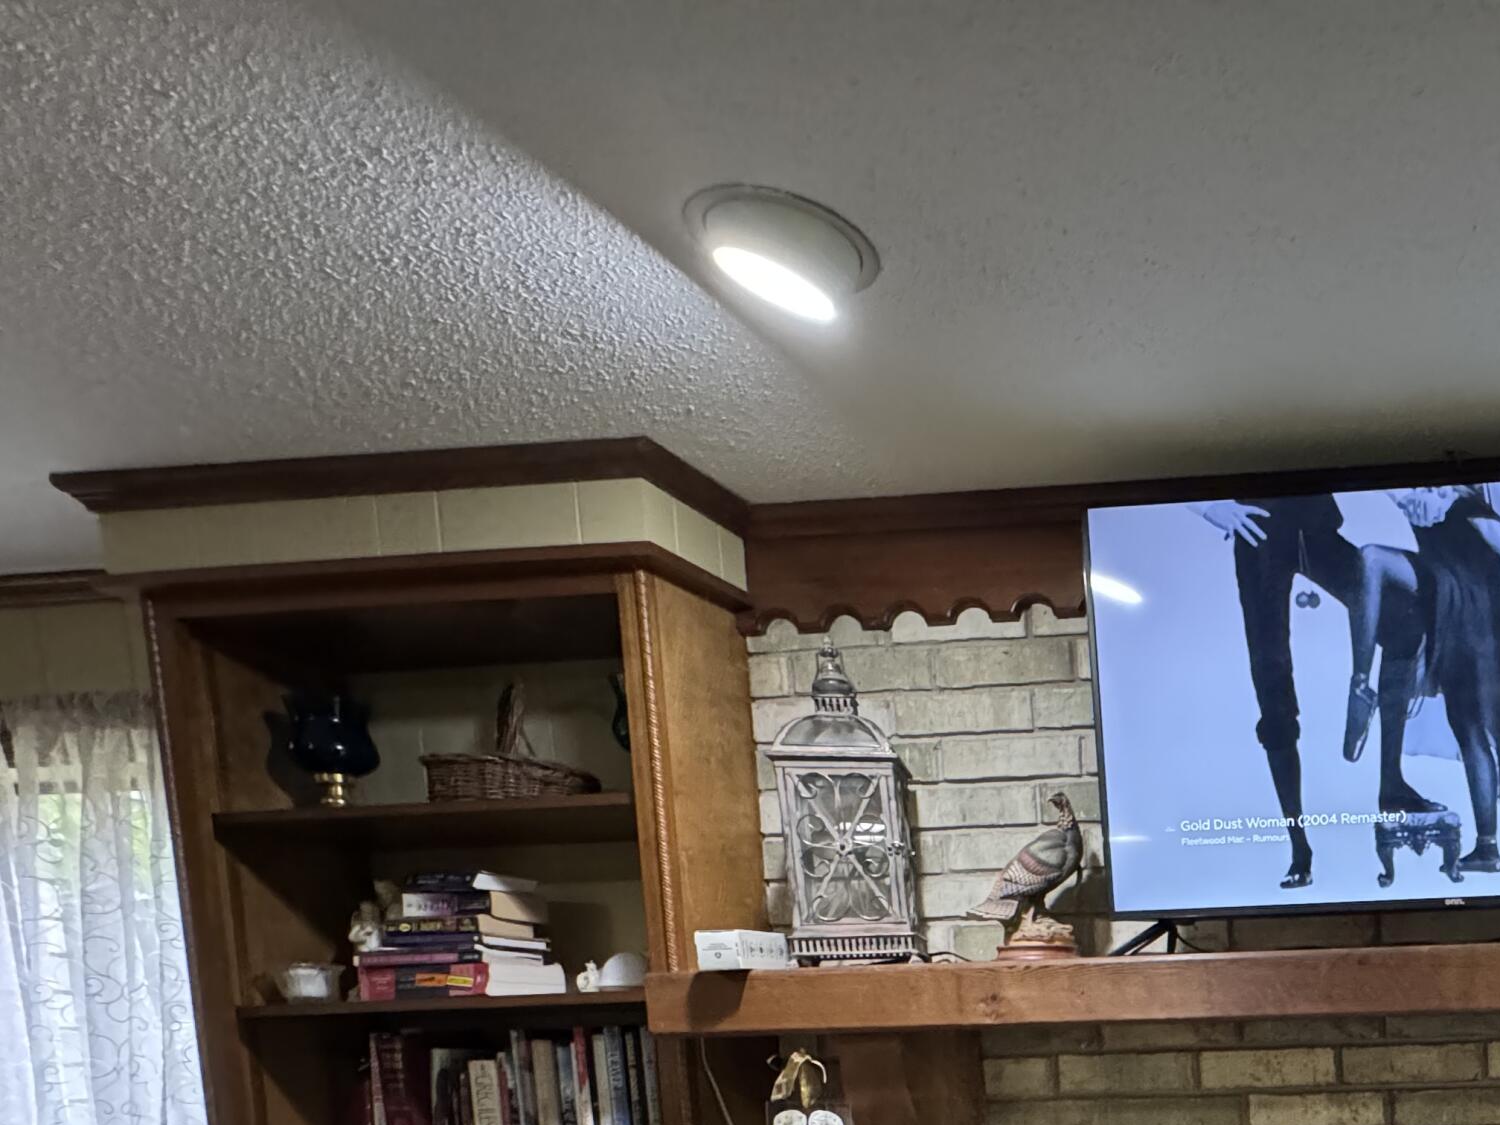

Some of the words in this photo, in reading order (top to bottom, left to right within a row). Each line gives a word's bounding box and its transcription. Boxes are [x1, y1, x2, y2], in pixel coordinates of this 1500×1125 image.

[1180, 819, 1210, 832] Gold
[1213, 817, 1243, 831] Dust
[1245, 816, 1295, 829] Woman
[1297, 813, 1338, 828] (2004
[1341, 809, 1407, 824] Remaster)
[1181, 836, 1226, 847] Fleetwood
[1227, 835, 1245, 845] Mac
[1252, 833, 1291, 844] Rumours
